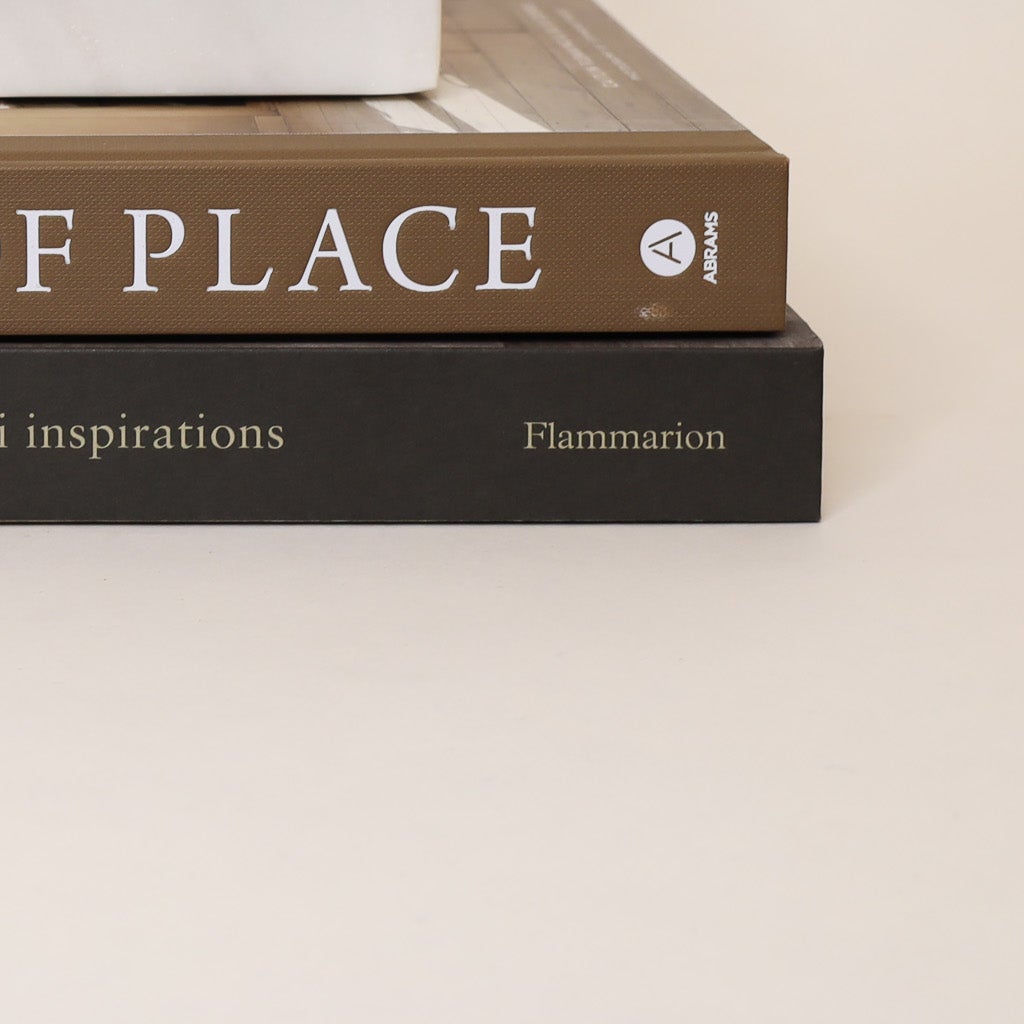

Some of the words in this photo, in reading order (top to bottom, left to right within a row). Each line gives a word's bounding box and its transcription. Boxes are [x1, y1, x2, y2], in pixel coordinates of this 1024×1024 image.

[122, 205, 542, 293] PLACE
[702, 210, 719, 285] ABRAMS
[26, 412, 285, 460] inspirations
[523, 421, 727, 450] Flammarion
